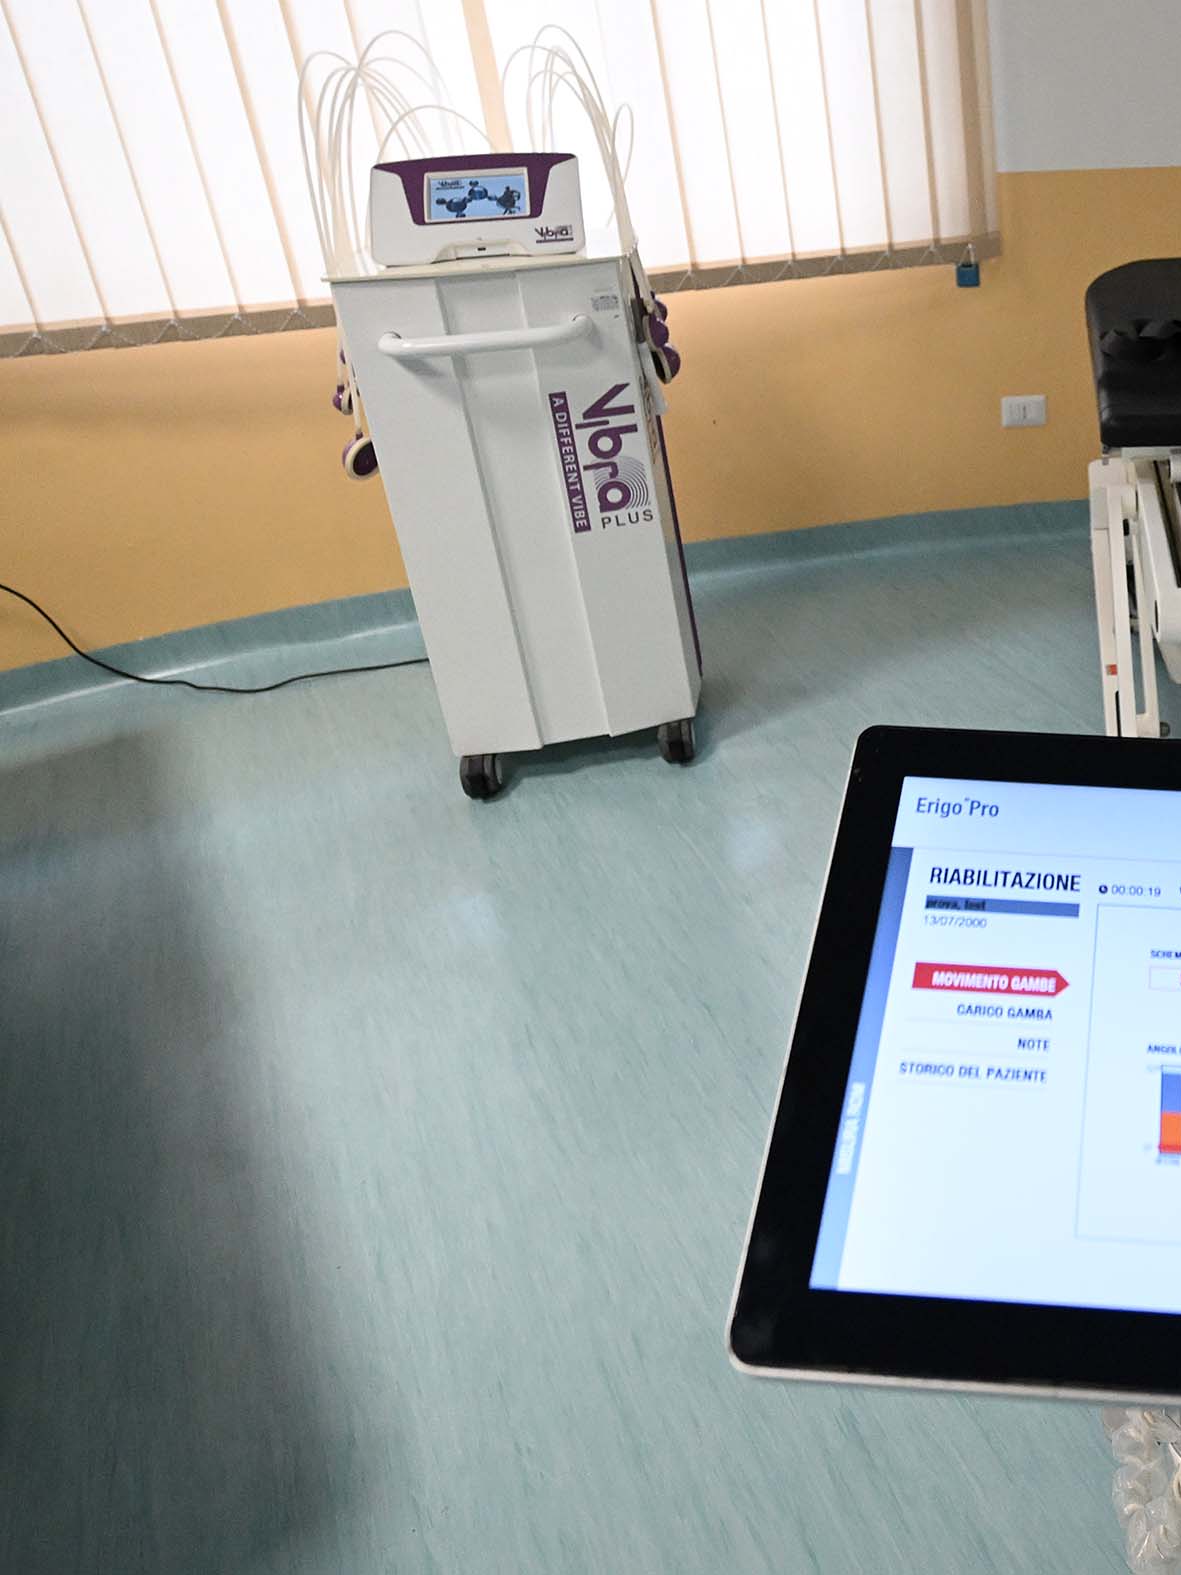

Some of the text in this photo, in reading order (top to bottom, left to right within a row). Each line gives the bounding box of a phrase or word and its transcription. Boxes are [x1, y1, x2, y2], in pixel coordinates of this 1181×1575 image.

[575, 382, 638, 513] Vibra
[551, 397, 588, 528] A DIFFERENT VIBE
[601, 509, 654, 529] PLUS
[930, 867, 1081, 892] RIABILITAZIONE
[1111, 884, 1161, 897] 00:00:19
[932, 971, 1057, 993] MOVIMENTO GAMBE
[956, 1003, 1053, 1020] CARICO GAMBA
[1017, 1038, 1050, 1052] NOTE
[899, 1061, 1048, 1083] STORICO DEL PAZIENTE
